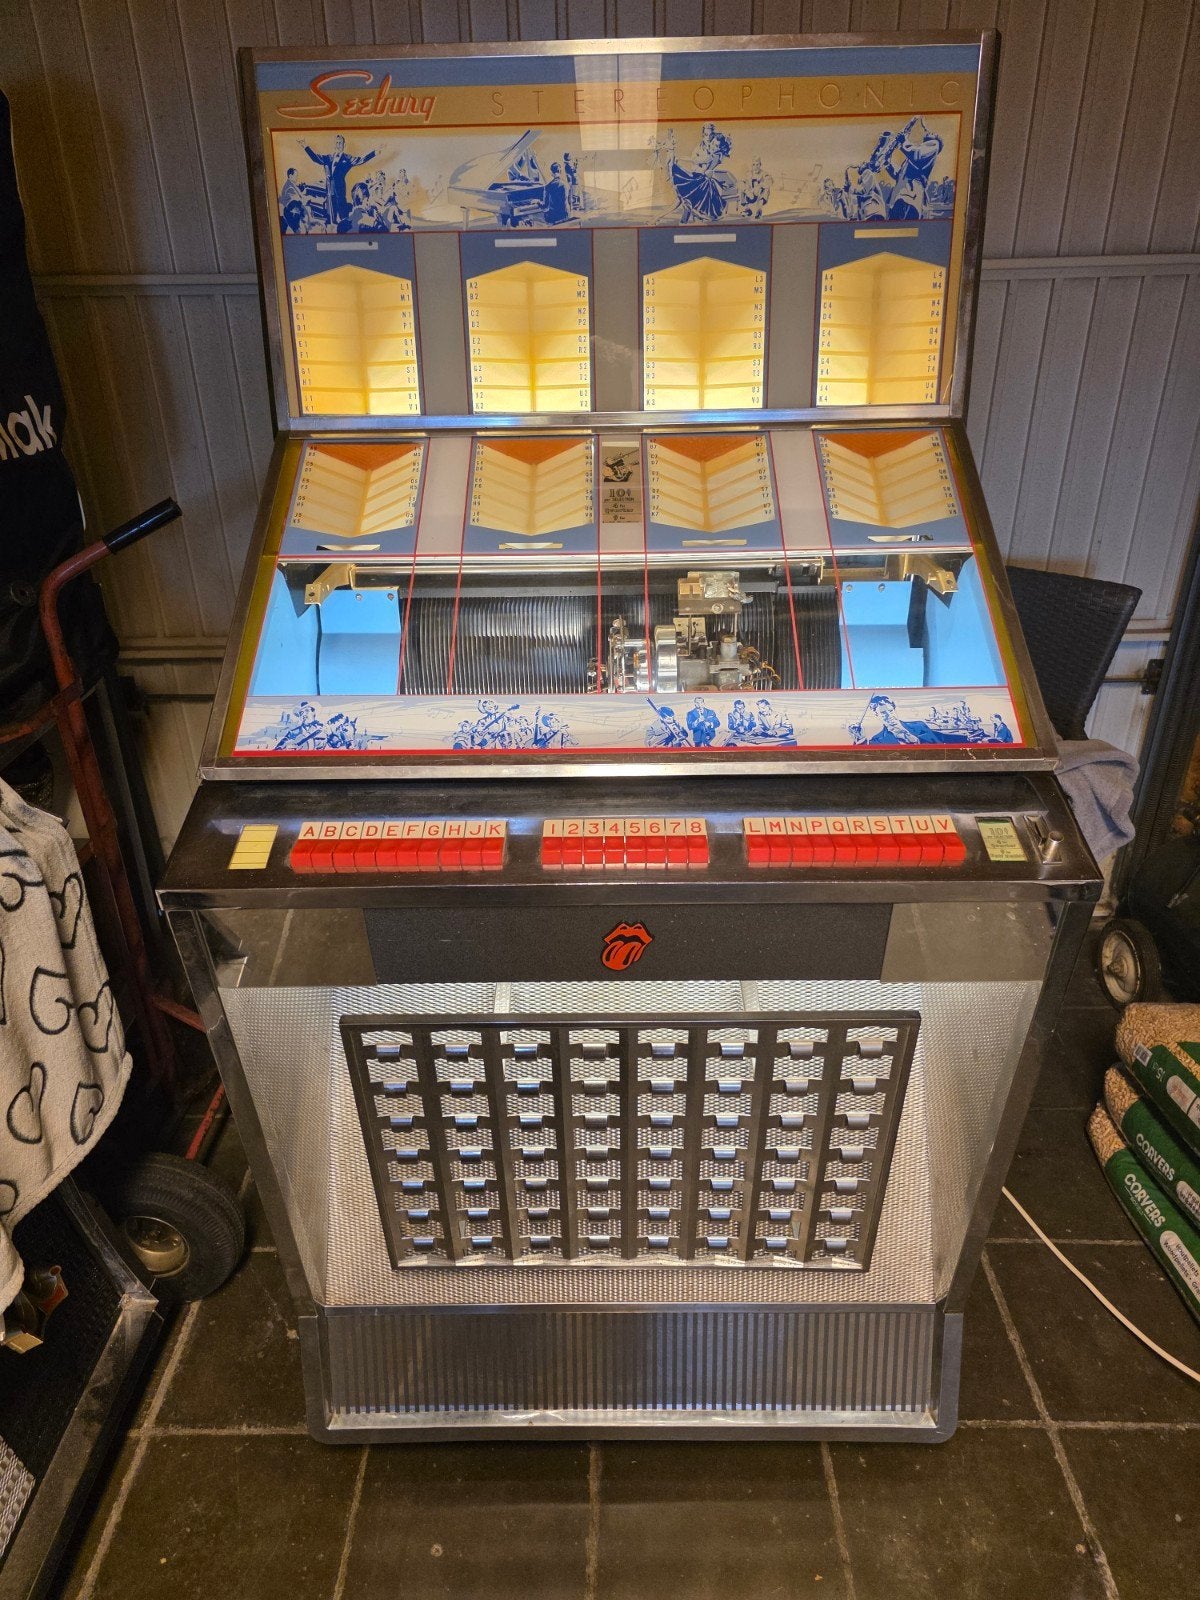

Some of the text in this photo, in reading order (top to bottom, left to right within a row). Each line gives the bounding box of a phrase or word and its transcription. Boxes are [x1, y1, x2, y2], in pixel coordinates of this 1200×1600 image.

[276, 70, 436, 123] Seeburg
[491, 80, 961, 117] STEREOPHONIC
[304, 824, 500, 837] A B C D E F G H J K
[551, 822, 701, 834] 1 2 3 4 5 6 7 8
[749, 819, 948, 832] L M N P Q R S T U V
[1136, 1134, 1175, 1181] CORVERS
[1124, 1174, 1166, 1228] CORVERS
